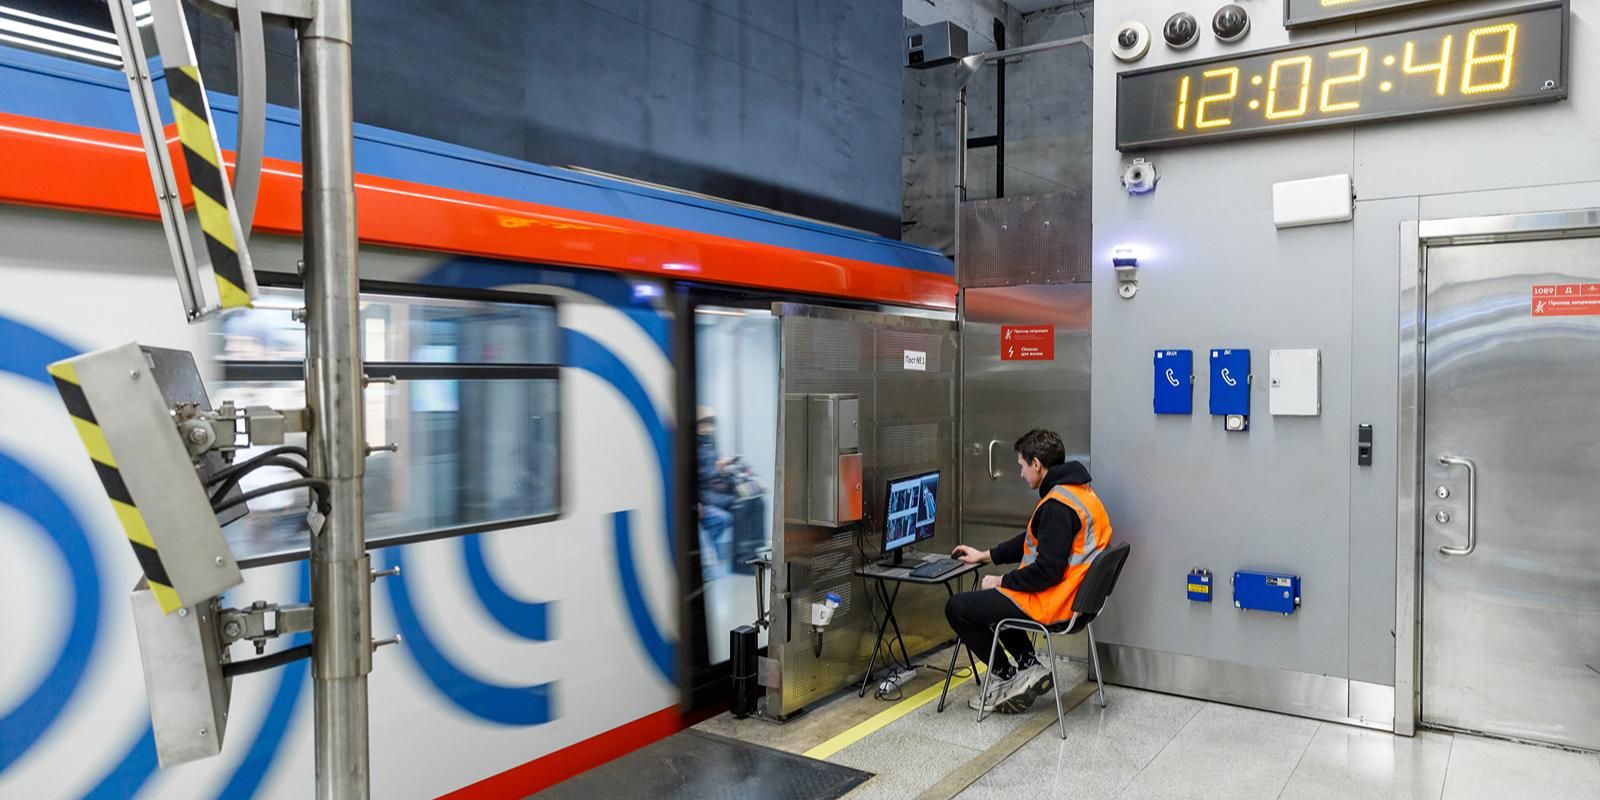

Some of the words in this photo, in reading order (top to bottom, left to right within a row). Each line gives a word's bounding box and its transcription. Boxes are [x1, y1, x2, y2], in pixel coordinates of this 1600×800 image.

[1176, 24, 1516, 129] 12:02:48
[1534, 287, 1554, 295] 1089
[1565, 287, 1572, 295] Д
[905, 355, 916, 364] Пост
